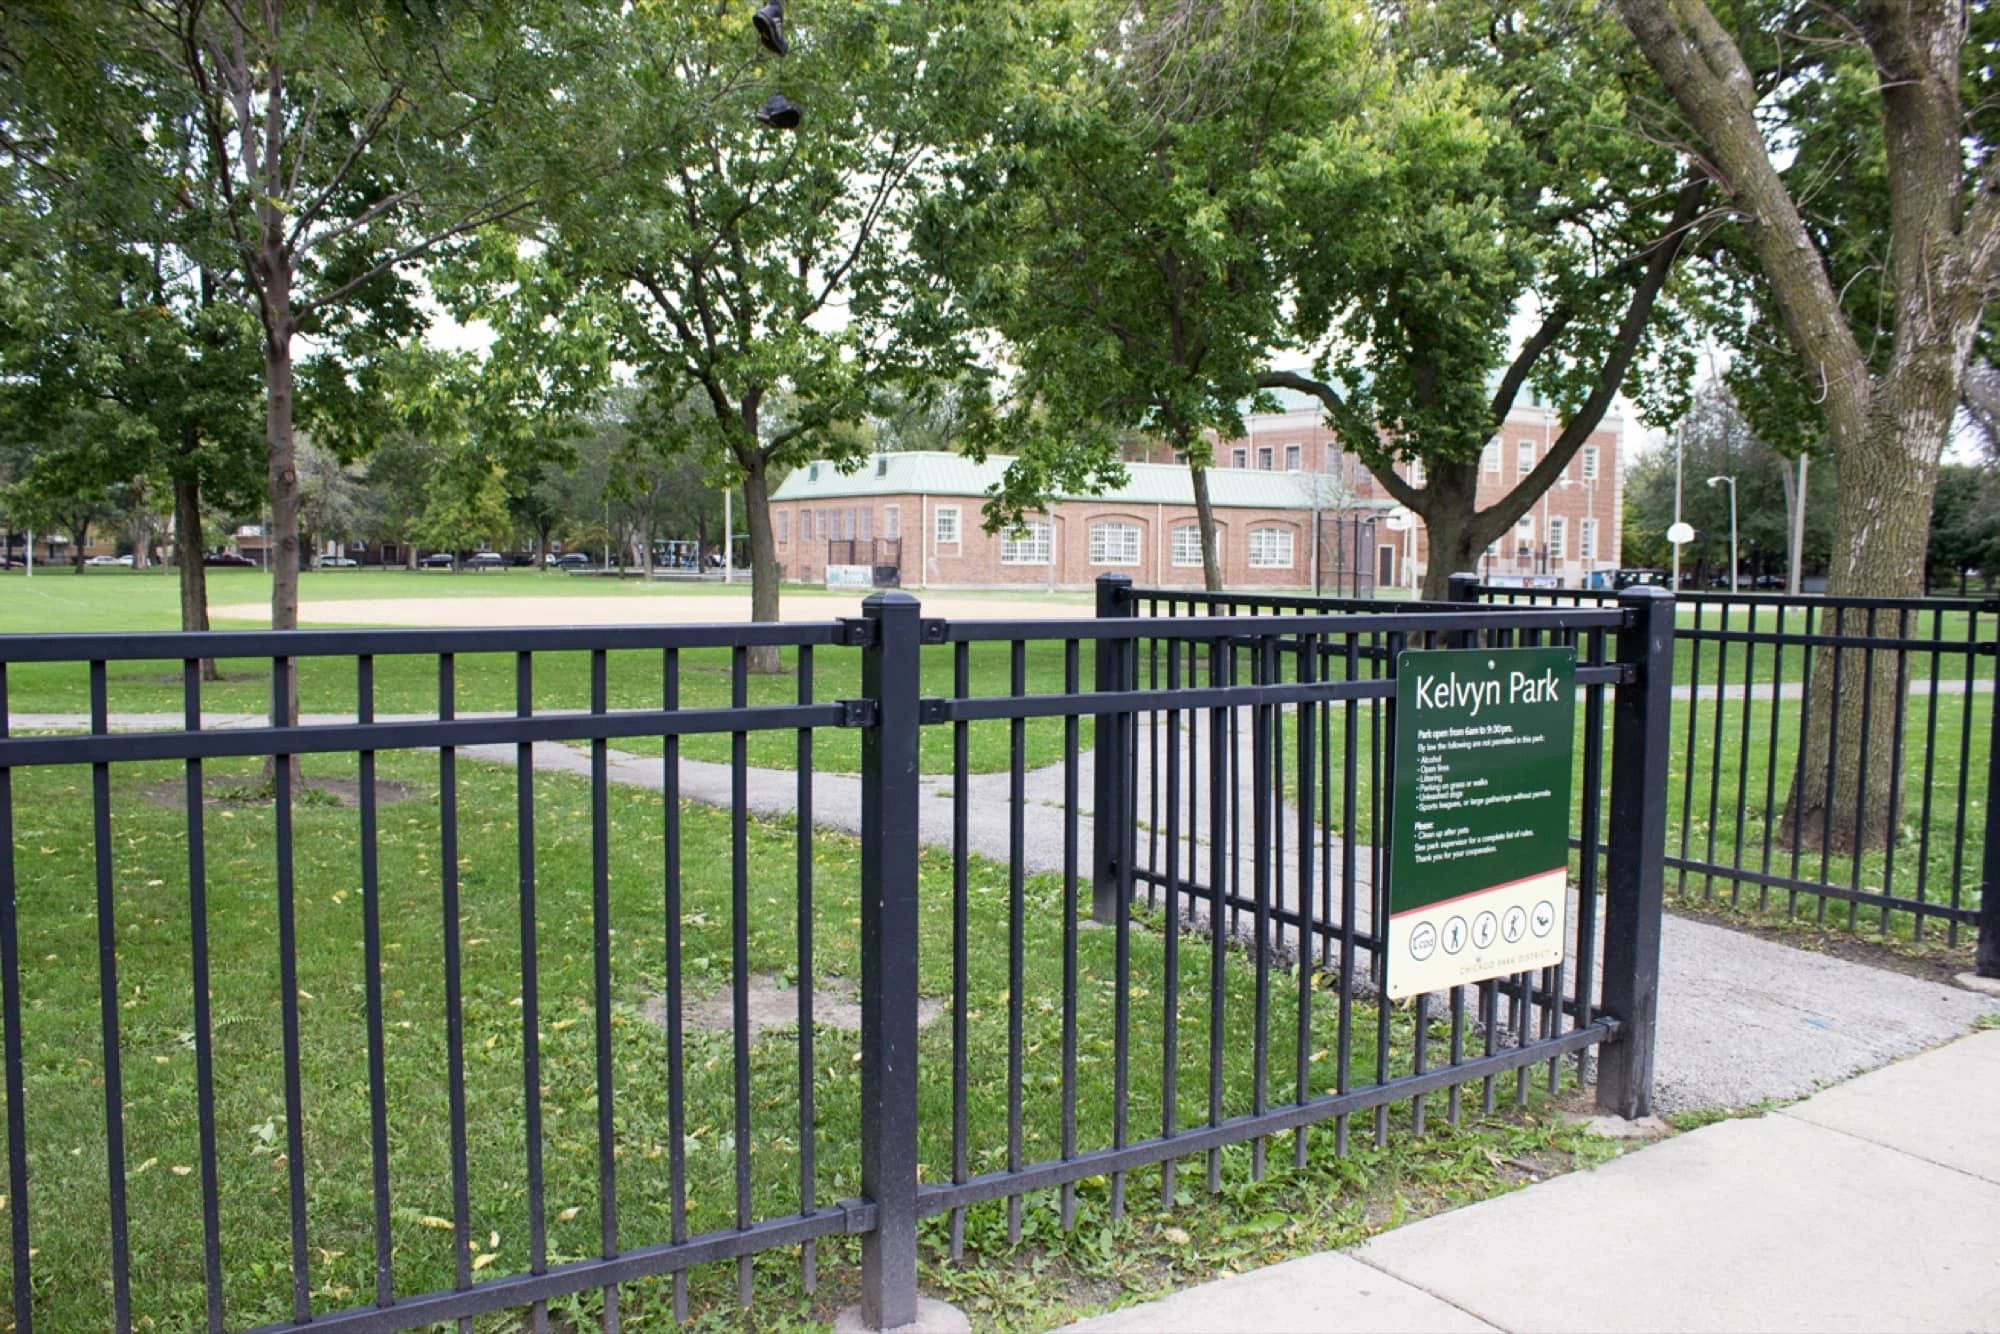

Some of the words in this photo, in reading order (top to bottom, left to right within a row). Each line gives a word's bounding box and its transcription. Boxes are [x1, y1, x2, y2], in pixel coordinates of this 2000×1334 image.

[1416, 672, 1500, 716] Kelvyn
[1510, 668, 1559, 704] Park
[1417, 729, 1432, 740] Park
[1433, 730, 1449, 740] open
[1449, 727, 1464, 737] from
[1480, 725, 1486, 735] to
[1447, 741, 1471, 750] following
[1420, 755, 1442, 764] Alcohol
[1420, 764, 1436, 774] Open
[1419, 783, 1441, 793] Parking
[1450, 781, 1465, 791] grass
[1473, 777, 1488, 786] walks
[1470, 798, 1484, 807] large
[1417, 830, 1435, 840] Clean
[1444, 828, 1457, 837] after
[1427, 841, 1440, 852] park
[1415, 853, 1433, 864] Thank
[1433, 854, 1443, 864] you
[1443, 850, 1452, 860] for
